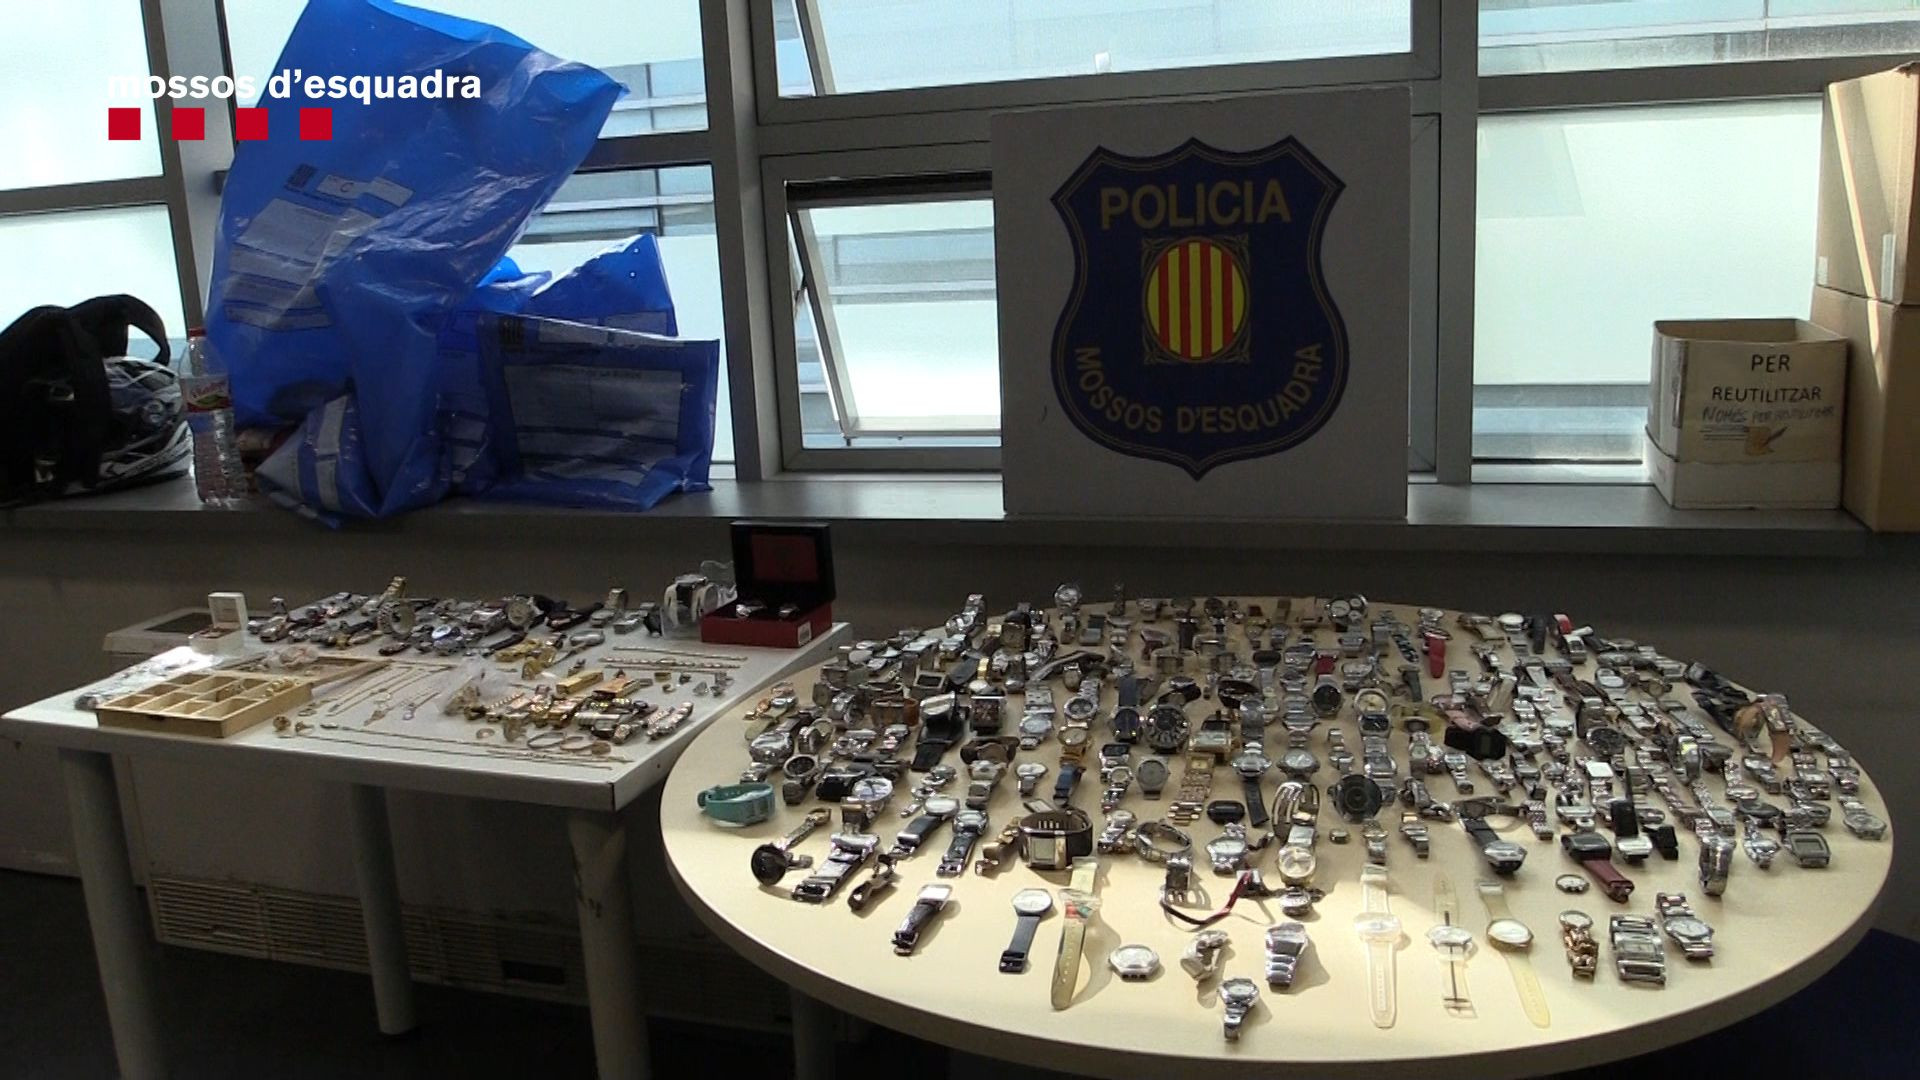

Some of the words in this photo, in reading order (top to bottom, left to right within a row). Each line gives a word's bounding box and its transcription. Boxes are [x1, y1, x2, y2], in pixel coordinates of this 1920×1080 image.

[1100, 178, 1292, 231] POLICIA
[1751, 354, 1791, 373] PER
[1074, 345, 1165, 434] MOSSOS
[1176, 342, 1324, 434] D'ESQUADRA
[1711, 386, 1822, 403] REUTILITZAR
